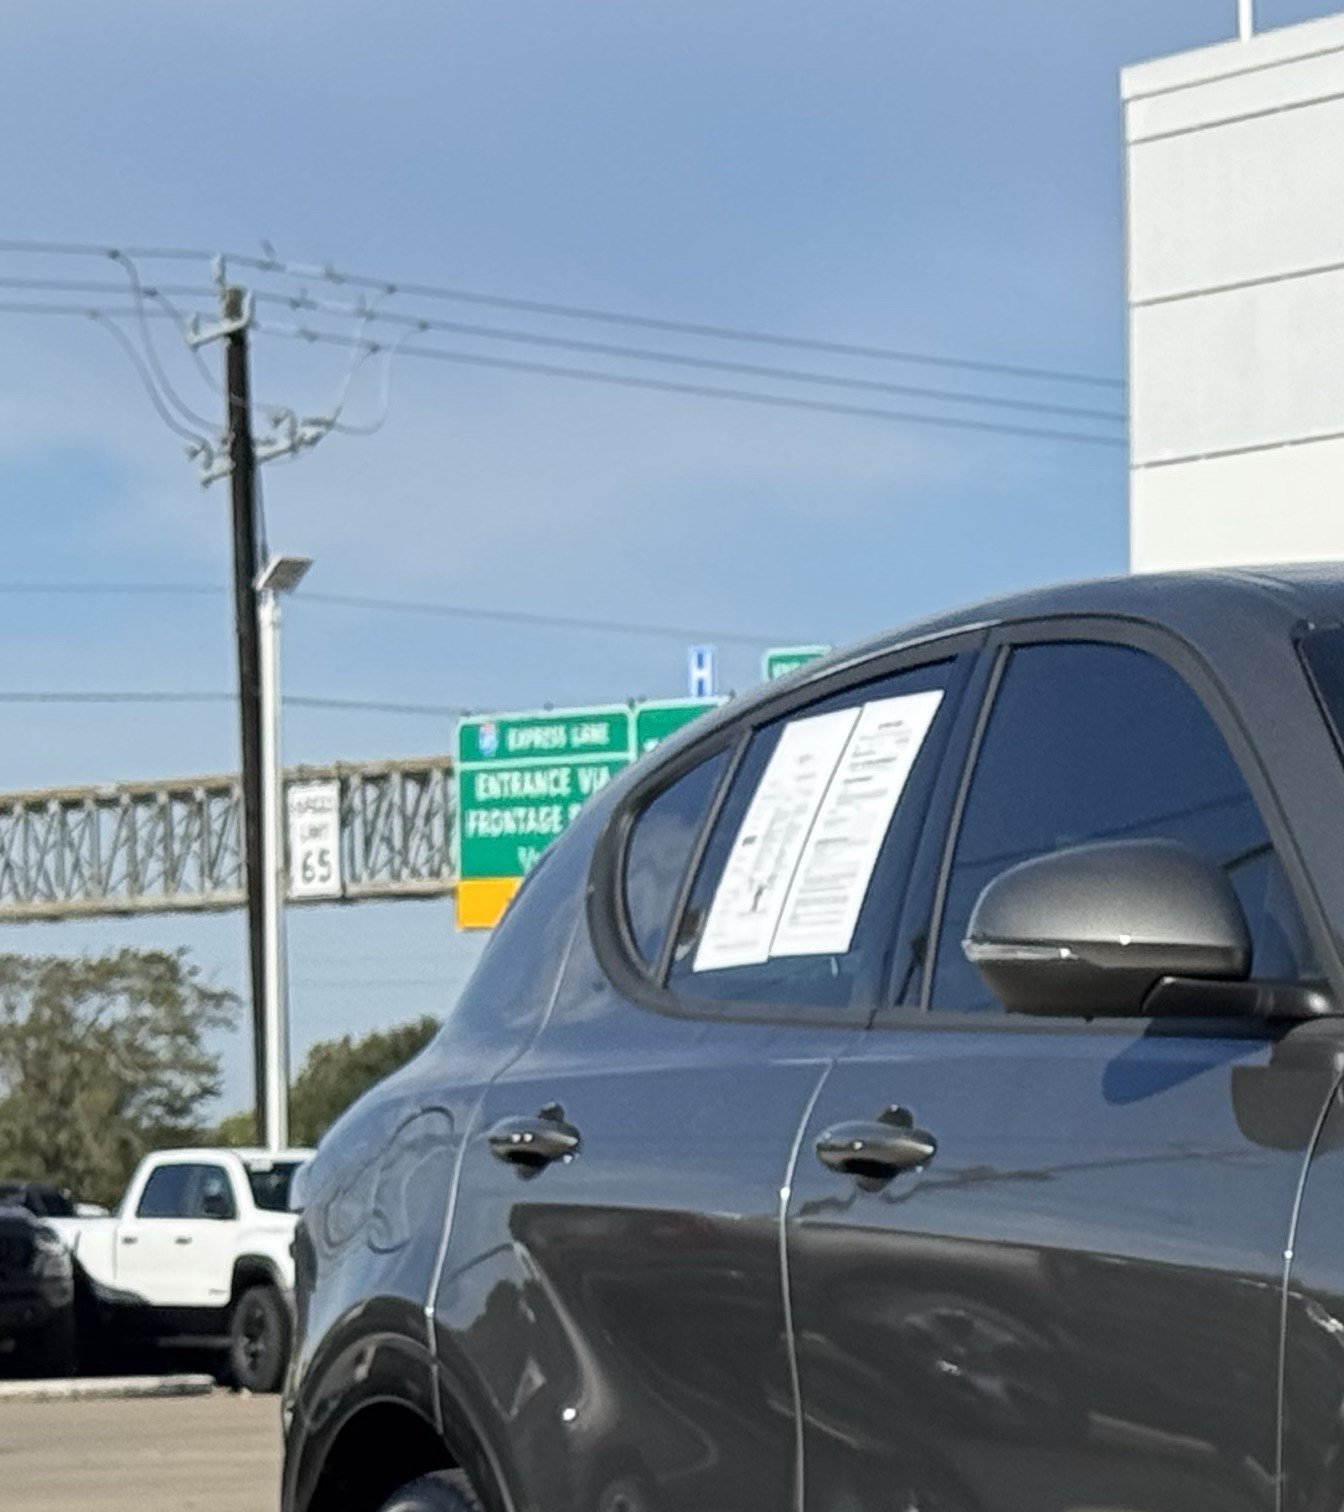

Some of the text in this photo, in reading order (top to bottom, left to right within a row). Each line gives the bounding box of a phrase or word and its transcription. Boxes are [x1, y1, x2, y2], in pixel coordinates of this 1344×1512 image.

[474, 764, 612, 801] ENTRANCE VIA
[464, 804, 563, 839] FRONTAGE
[301, 847, 332, 884] 65
